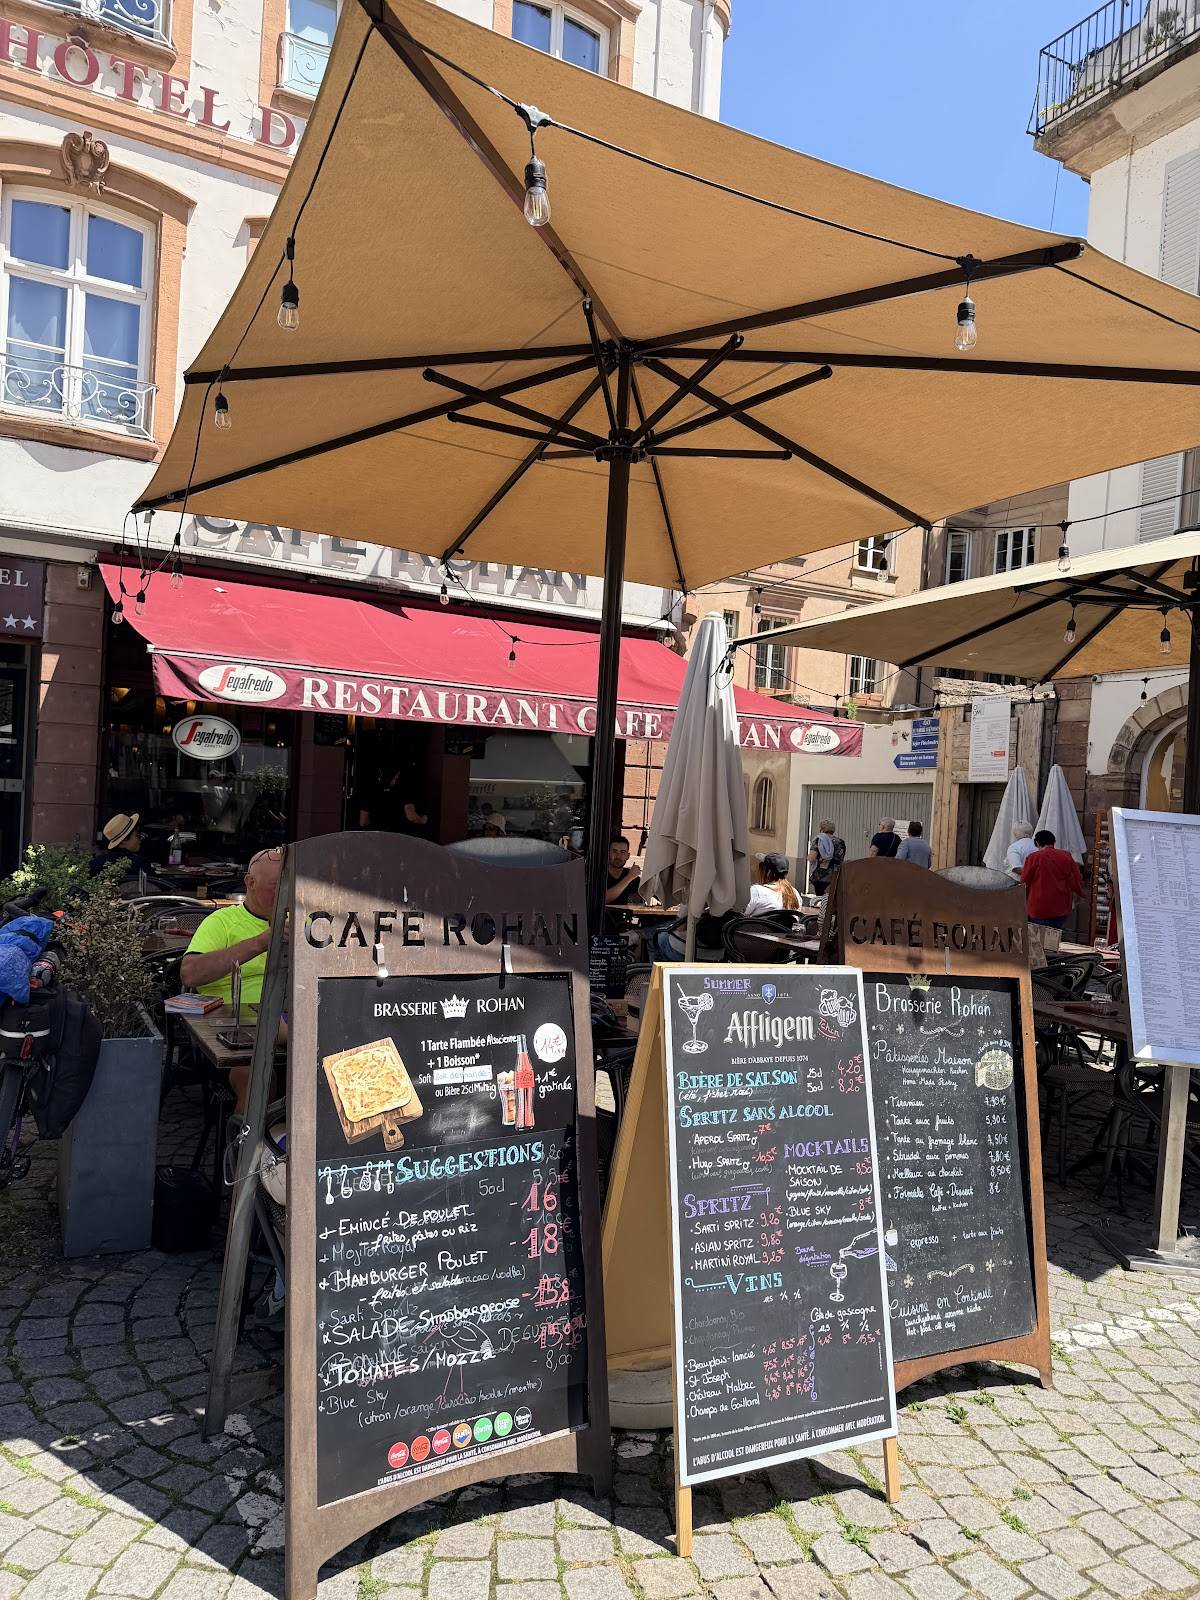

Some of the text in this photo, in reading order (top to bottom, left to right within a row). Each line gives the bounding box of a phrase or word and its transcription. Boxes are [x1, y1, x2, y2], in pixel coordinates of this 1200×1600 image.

[212, 666, 274, 693] Segafredo
[300, 676, 564, 729] RESTAURANT
[180, 721, 234, 747] Segafredo
[442, 910, 580, 947] ROHAN
[849, 912, 1024, 954] CAFÉ ROHAN
[703, 977, 751, 990] SUMMER
[373, 996, 526, 1018] BRASSERIE ROHAN
[875, 982, 991, 1017] Brasserie Rohan
[723, 1010, 816, 1048] Affligem
[420, 1040, 426, 1052] 1
[427, 1039, 449, 1051] Tarte
[450, 1036, 486, 1050] Flambée
[873, 1039, 929, 1063] Pâtisseries
[933, 1047, 974, 1065] Maison
[774, 1055, 796, 1063] DEPUIS
[418, 1073, 432, 1085] Soft
[676, 1069, 724, 1090] BIÈRE
[726, 1072, 744, 1088] DE
[745, 1069, 798, 1088] SAISON
[435, 1089, 443, 1098] ou
[444, 1085, 460, 1097] Bière
[679, 1103, 834, 1128] SPRITZ SANS ALCOOL
[890, 1113, 913, 1126] Tarte
[915, 1117, 931, 1126] aux
[934, 1114, 955, 1132] fruits
[694, 1132, 725, 1146] APEROL
[783, 1137, 869, 1159] MOCKTAILS
[890, 1131, 912, 1144] Tarte
[915, 1137, 925, 1145] au
[927, 1135, 956, 1153] fromage
[958, 1133, 979, 1146] blanc
[395, 1141, 543, 1184] SUGGESTIONS
[830, 1164, 844, 1175] DE
[938, 1166, 964, 1178] chocolat
[789, 1176, 822, 1188] SAISON
[683, 1193, 752, 1219] SPRITZ
[787, 1204, 832, 1218] BLUE SKY
[693, 1220, 720, 1235] SARTI
[724, 1218, 755, 1232] SPRITZ
[694, 1240, 721, 1254] ASIAN
[723, 1238, 755, 1251] SPRITZ
[438, 1250, 488, 1271] POULET
[732, 1252, 761, 1268] ROYAL
[724, 1271, 783, 1296] VINS
[837, 1305, 877, 1322] gascogne
[889, 1298, 929, 1320] Cuisine
[944, 1320, 957, 1332] day
[689, 1368, 731, 1388] St Joseph
[726, 1378, 757, 1394] Malbec
[692, 1454, 711, 1468] L'ABUS
[711, 1450, 735, 1464] D'ALCOOL
[735, 1447, 745, 1457] EST
[745, 1440, 774, 1455] DANGEREUX
[774, 1437, 788, 1448] POUR
[788, 1435, 795, 1445] LA
[815, 1423, 845, 1438] CONSOMMER
[845, 1420, 856, 1431] AVEC
[377, 1475, 393, 1486] L'ABUS
[393, 1469, 413, 1482] D'ALCOOL
